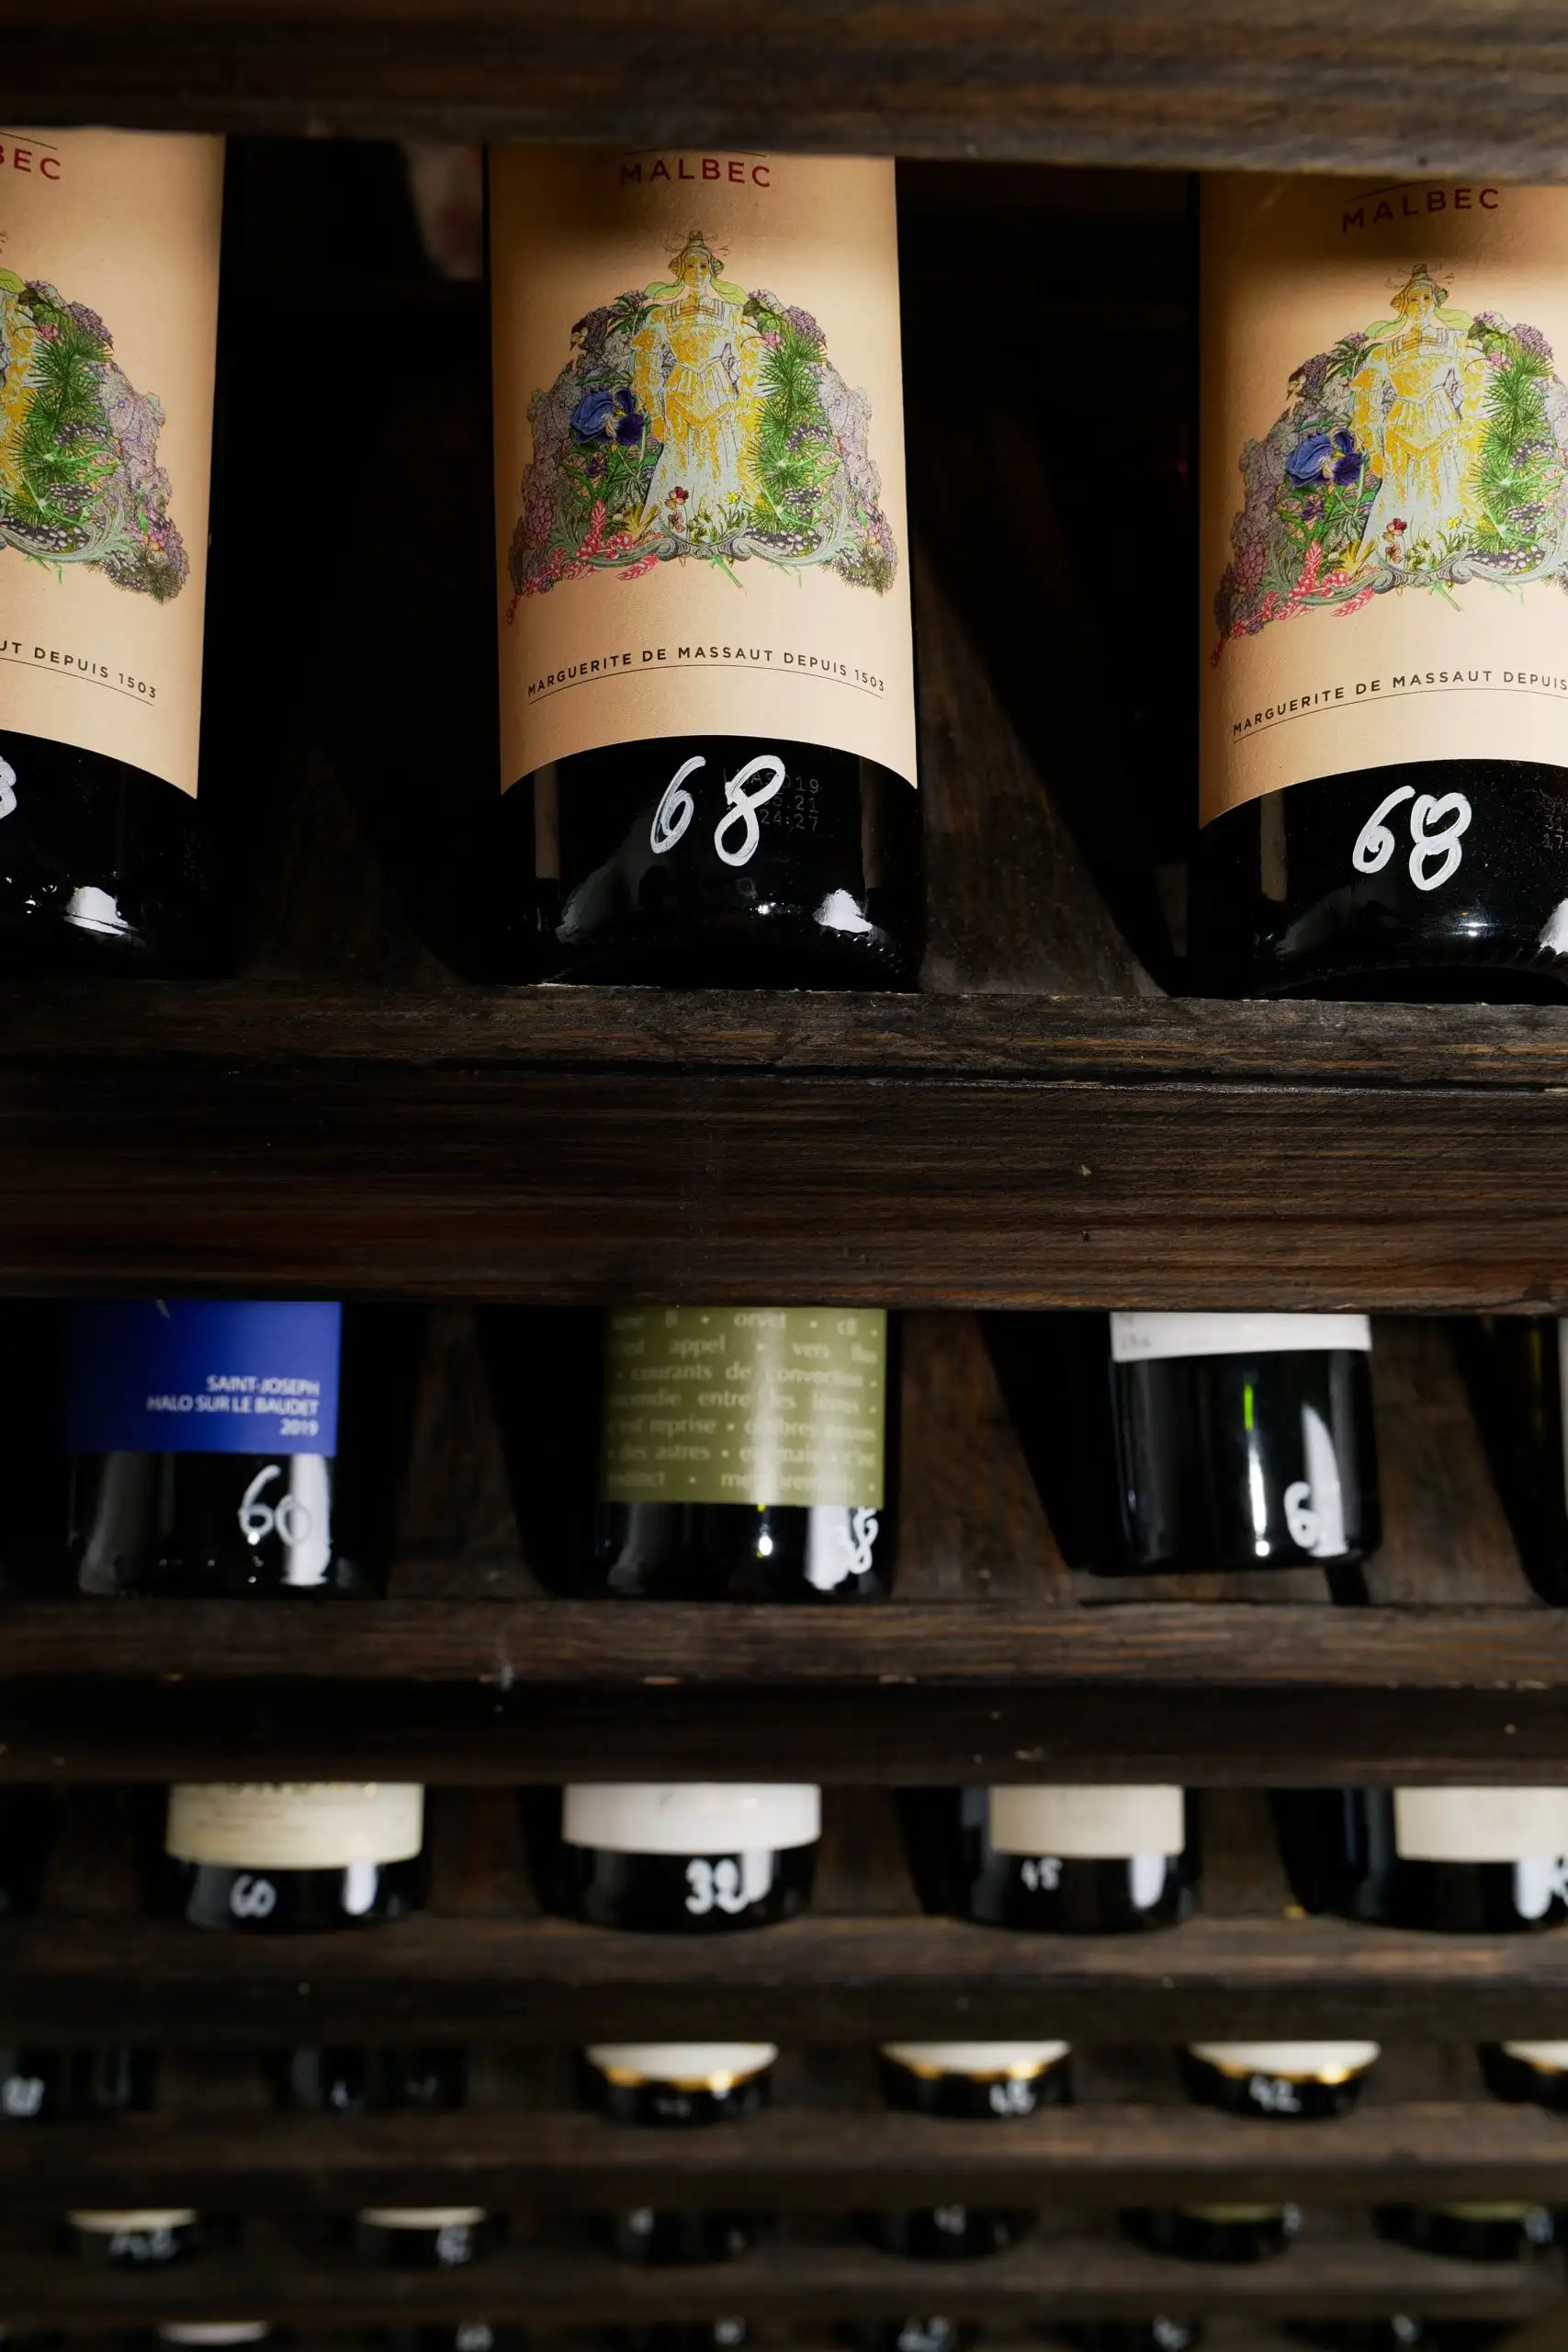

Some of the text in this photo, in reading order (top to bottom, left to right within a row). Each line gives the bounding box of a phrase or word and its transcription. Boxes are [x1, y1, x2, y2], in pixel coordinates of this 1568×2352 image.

[0, 144, 62, 180] EC
[619, 158, 771, 187] MALBEC
[1342, 187, 1499, 233] MALBEC
[34, 647, 108, 678] DEPUIS
[118, 673, 157, 698] 1503
[527, 646, 886, 697] MARGUERITE DE MASSAUT DEPUIS 1503
[1233, 670, 1568, 736] MARGUERITE DE MASSAUT DEPUIS
[649, 754, 786, 867] 68
[1351, 785, 1472, 891] 68
[669, 1334, 726, 1357] appel
[146, 1394, 194, 1412] HALO
[195, 1395, 230, 1413] SUR
[231, 1396, 253, 1413] LE
[697, 1389, 751, 1408] entre
[237, 1464, 310, 1547] 60
